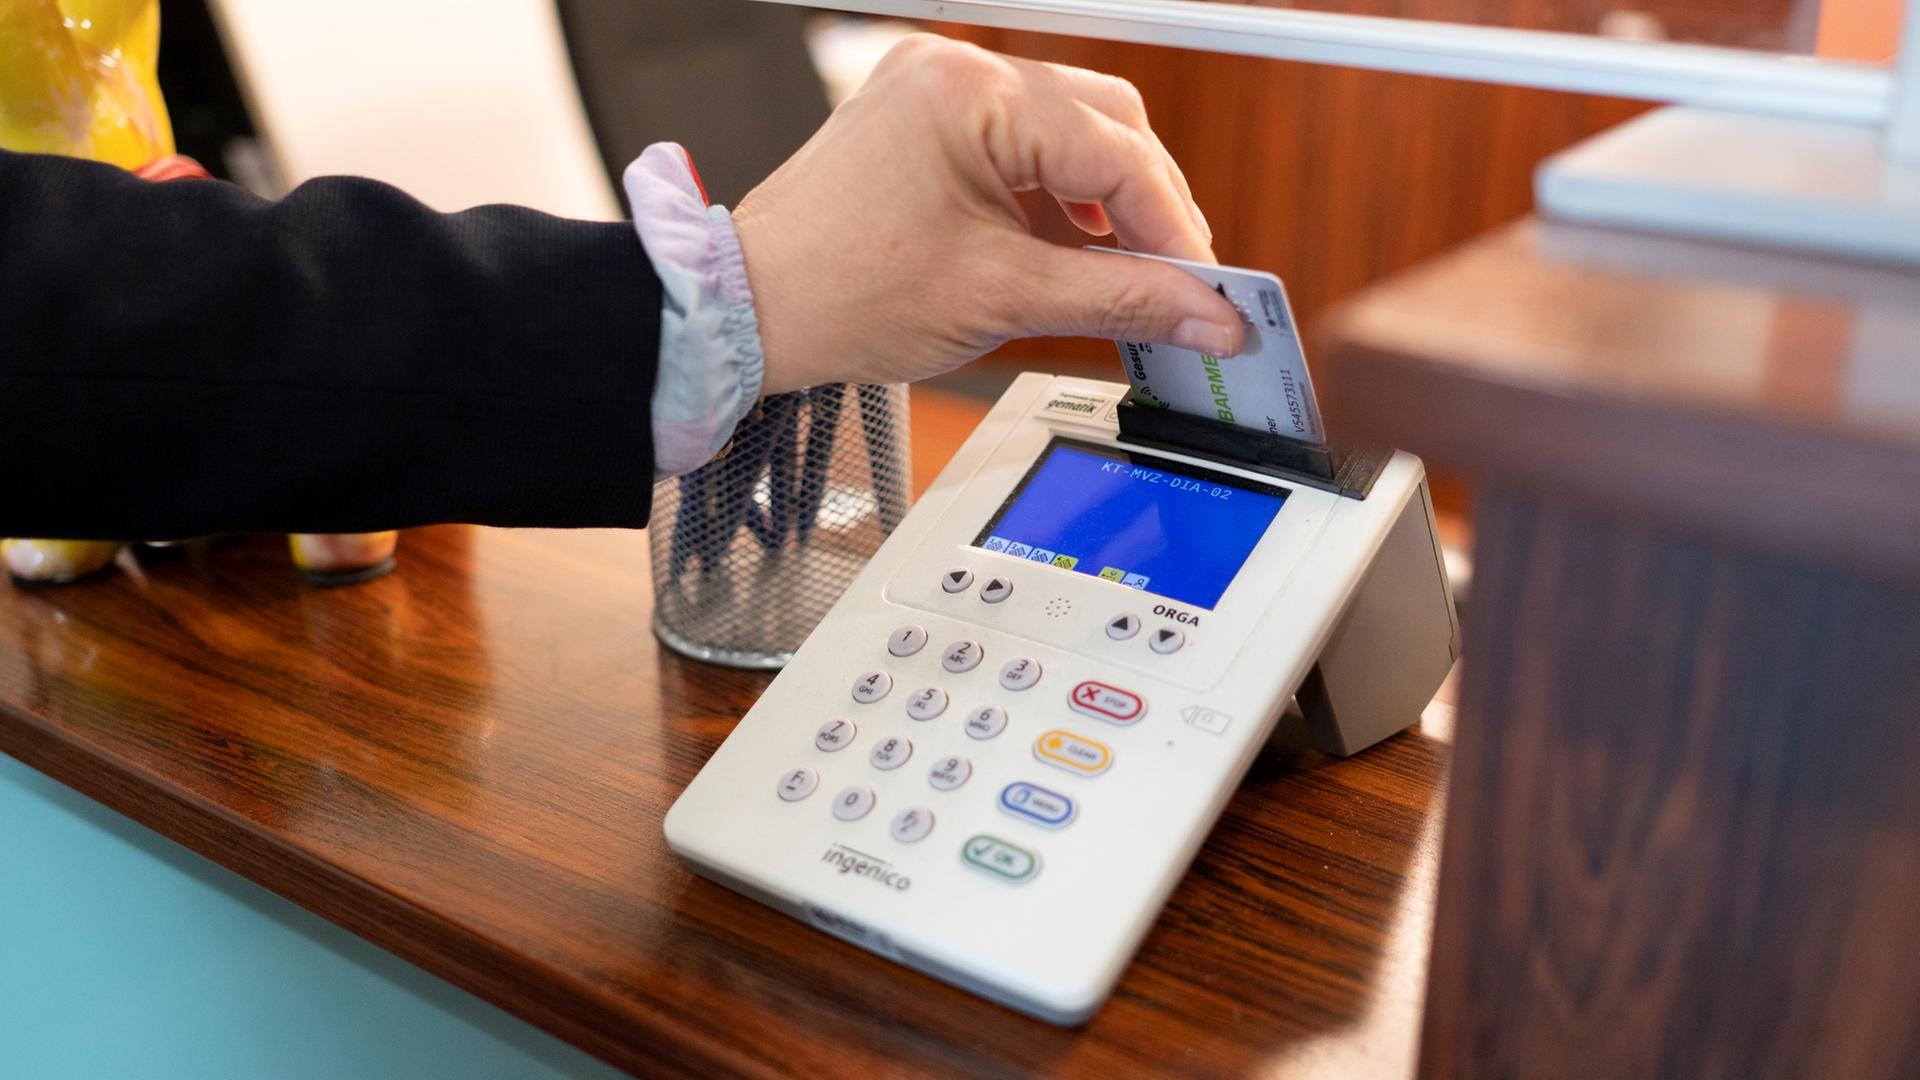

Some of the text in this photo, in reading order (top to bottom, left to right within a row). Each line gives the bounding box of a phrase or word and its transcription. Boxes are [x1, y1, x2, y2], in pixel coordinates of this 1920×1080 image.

[1045, 399, 1097, 414] gematik
[1101, 461, 1233, 501] KT-MVZ-DIA-02
[1153, 604, 1201, 628] ORGA
[902, 630, 913, 642] 1
[957, 642, 972, 654] 2
[948, 654, 967, 664] ABC
[1014, 659, 1029, 672] 3
[866, 673, 880, 685] 4
[1006, 671, 1022, 681] DEF
[858, 685, 874, 695] GHI
[922, 688, 937, 701] 5
[980, 708, 994, 721] 6
[830, 720, 845, 733] 7
[884, 738, 898, 752] 8
[944, 758, 959, 772] 9
[845, 792, 859, 806] 0
[821, 845, 912, 891] ingenico
